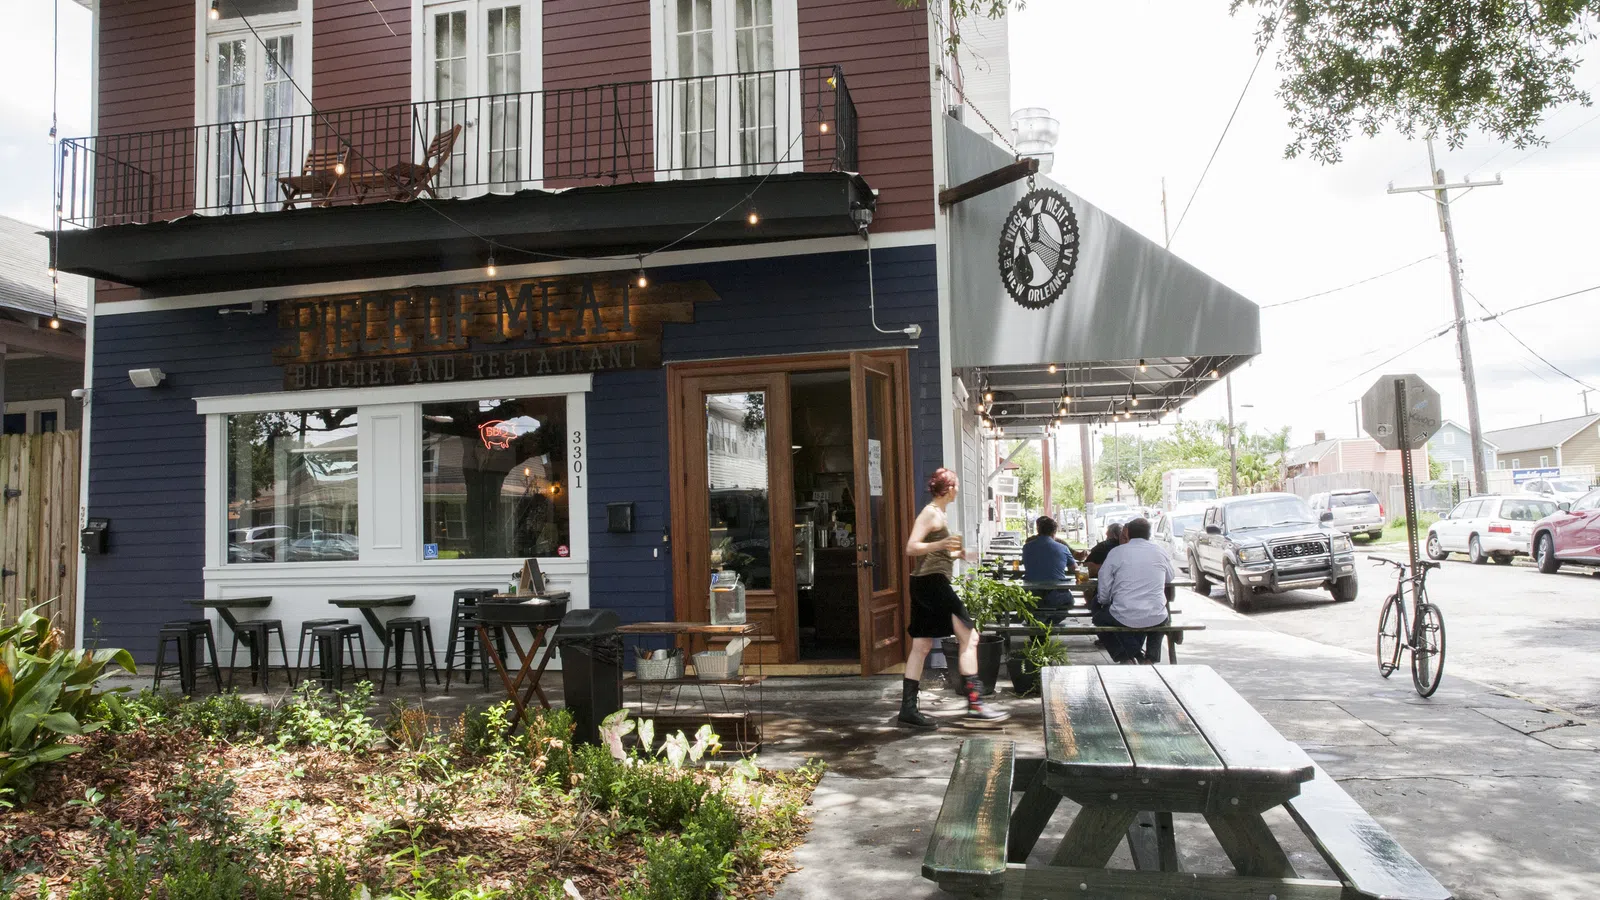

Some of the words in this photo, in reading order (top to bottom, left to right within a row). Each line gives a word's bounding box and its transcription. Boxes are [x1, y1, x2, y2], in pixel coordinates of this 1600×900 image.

[1005, 209, 1025, 242] PIECE
[1029, 199, 1036, 209] OF
[1045, 197, 1068, 222] MEAT
[1006, 270, 1025, 296] NEW
[1063, 248, 1073, 265] LA
[293, 295, 412, 356] PIECE
[424, 286, 480, 346] OF
[494, 274, 638, 343] MEAT
[295, 361, 396, 388] BUTCHER
[408, 357, 455, 383] AND
[471, 344, 639, 379] RESTAURANT
[486, 426, 508, 437] BBQ
[573, 431, 582, 489] 3301
